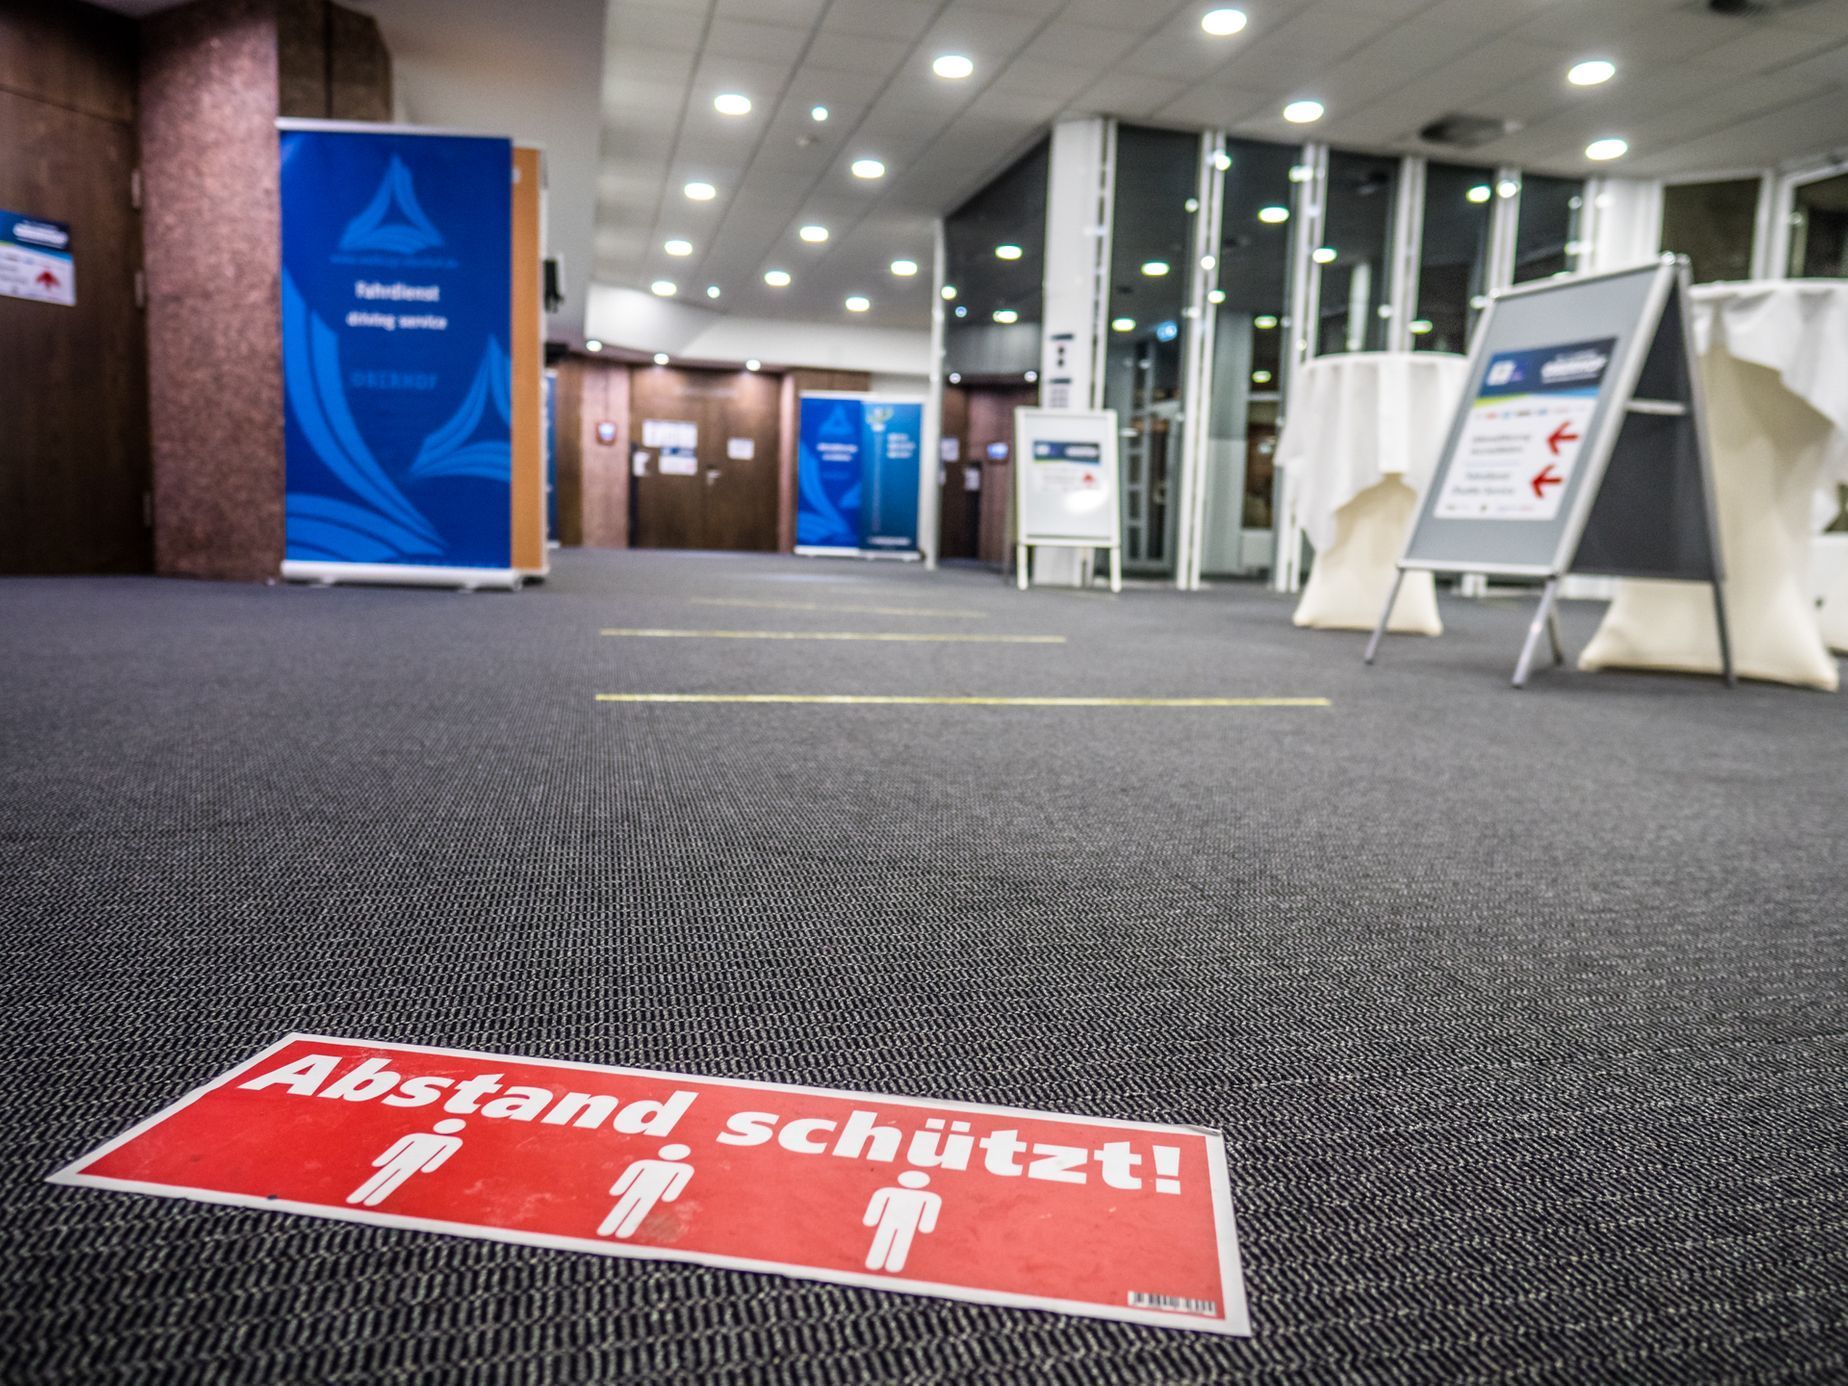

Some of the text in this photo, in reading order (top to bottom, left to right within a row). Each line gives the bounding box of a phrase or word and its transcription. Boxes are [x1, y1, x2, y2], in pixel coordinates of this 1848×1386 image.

[345, 311, 448, 331] driving service
[237, 1053, 1181, 1196] Abstand schützt!
